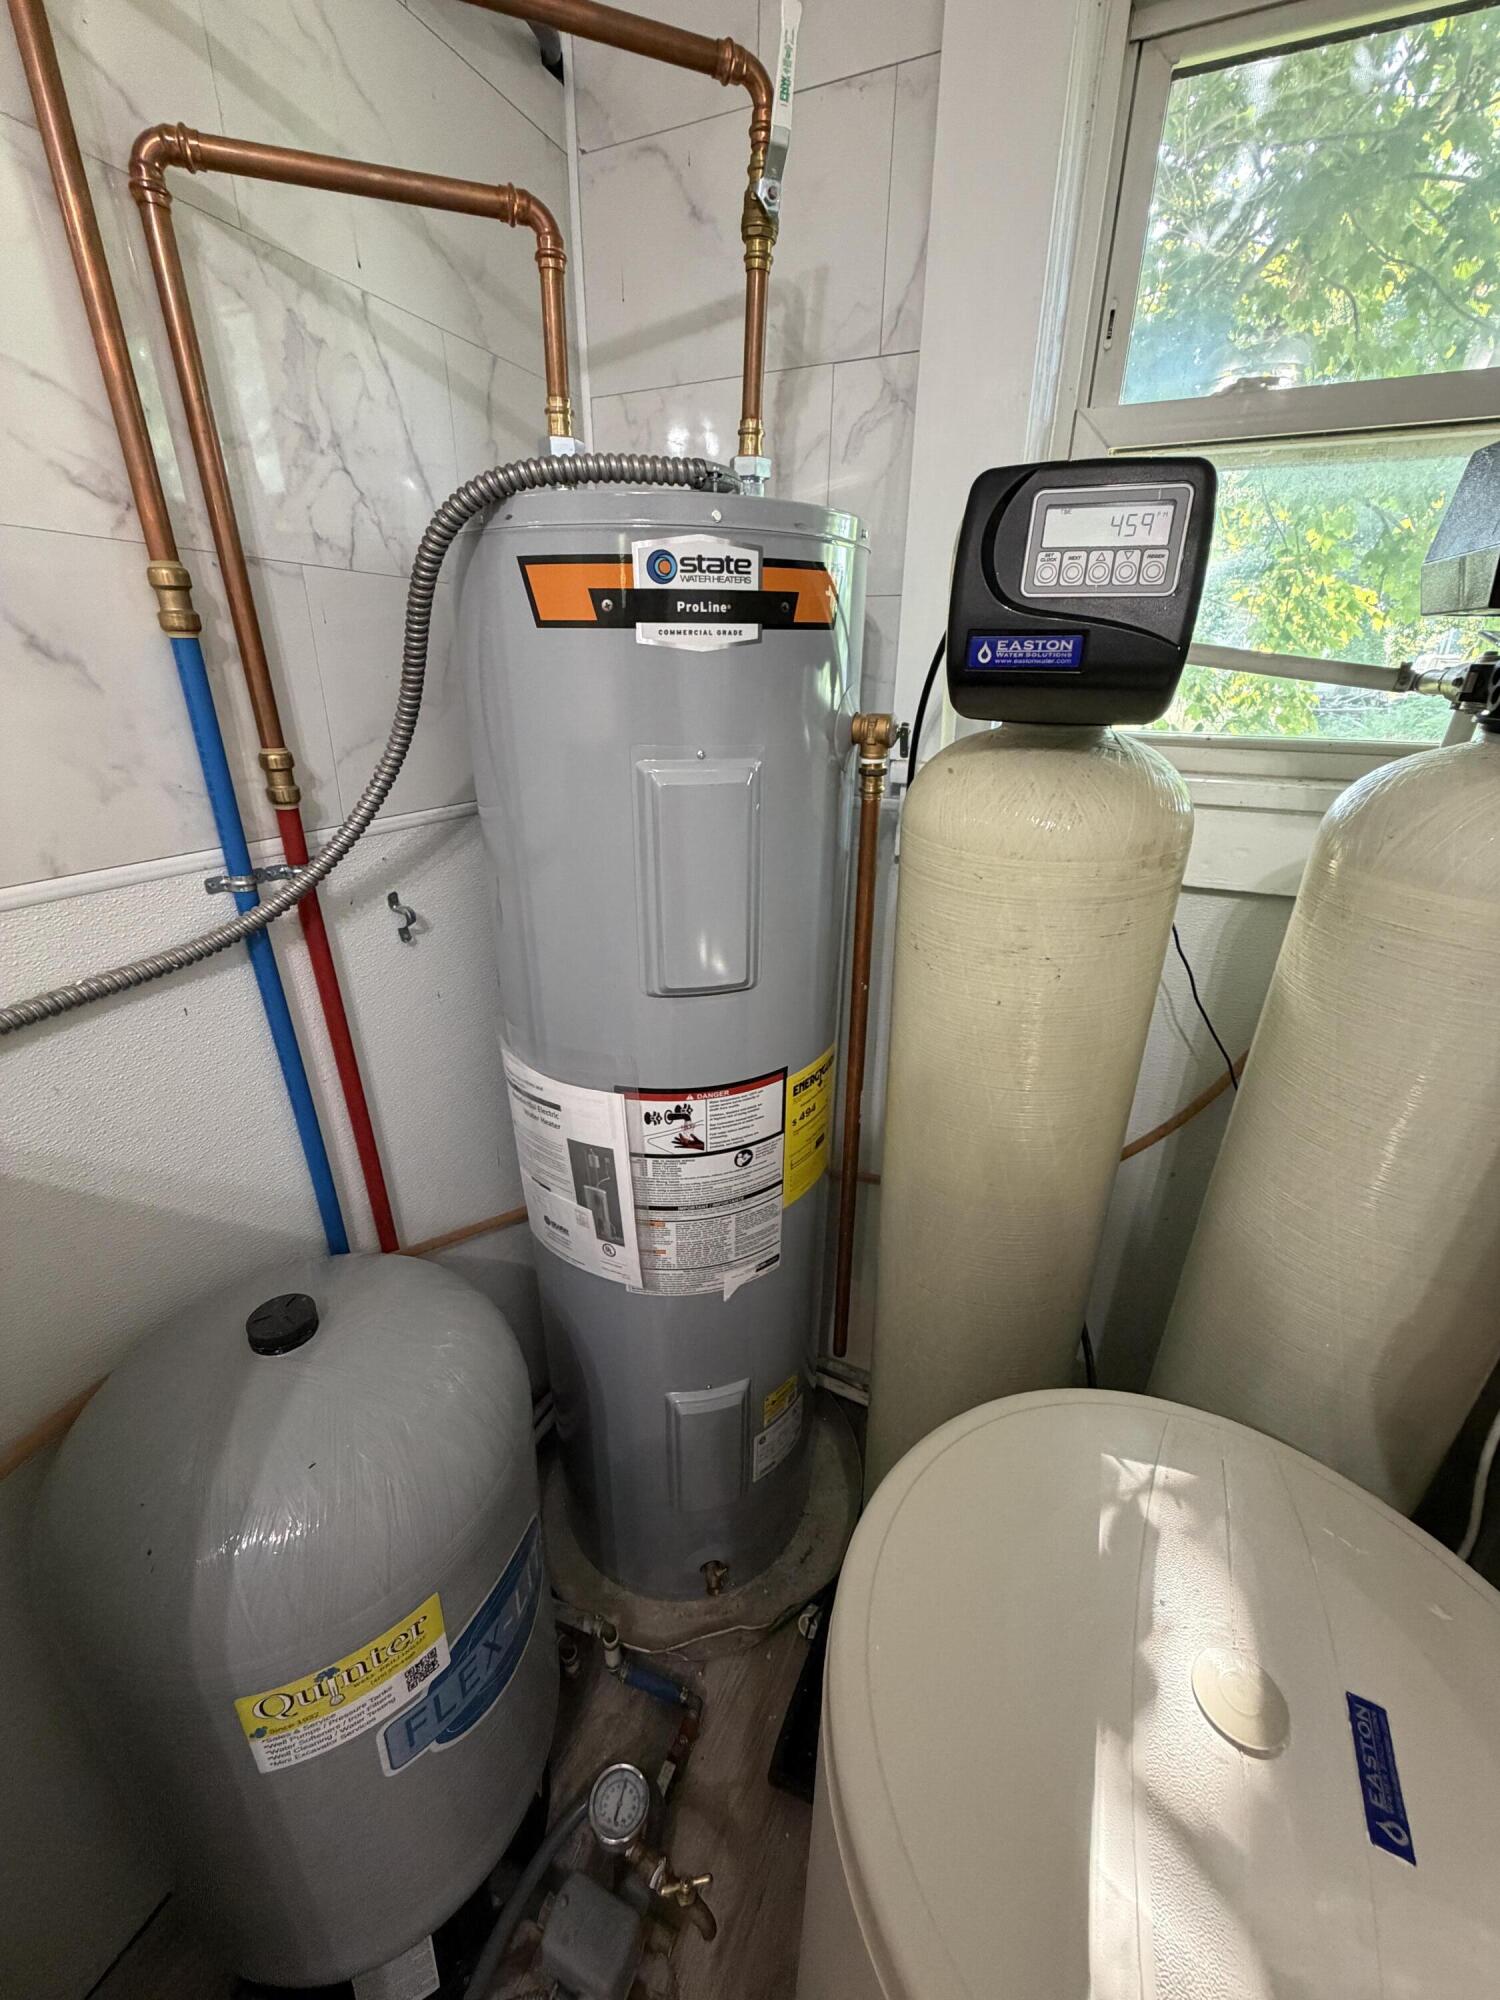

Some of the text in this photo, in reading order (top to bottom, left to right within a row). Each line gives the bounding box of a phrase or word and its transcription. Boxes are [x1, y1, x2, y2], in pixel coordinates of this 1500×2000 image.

[679, 554, 752, 575] state
[679, 575, 752, 584] WATER HEATERS
[997, 639, 1074, 651] EASTON
[696, 1089, 730, 1100] DANGER
[251, 1614, 428, 1720] Quinter
[289, 1727, 321, 1742] Pumps
[328, 1702, 367, 1726] Pressure
[368, 1685, 393, 1703] Tanks
[302, 1713, 337, 1729] Service
[293, 1735, 333, 1753] Cleaning
[340, 1717, 365, 1733] Water
[293, 1739, 337, 1760] Excavator
[340, 1717, 377, 1740] Services
[298, 1724, 341, 1745] Softeners
[1355, 1703, 1388, 1811] EASTON
